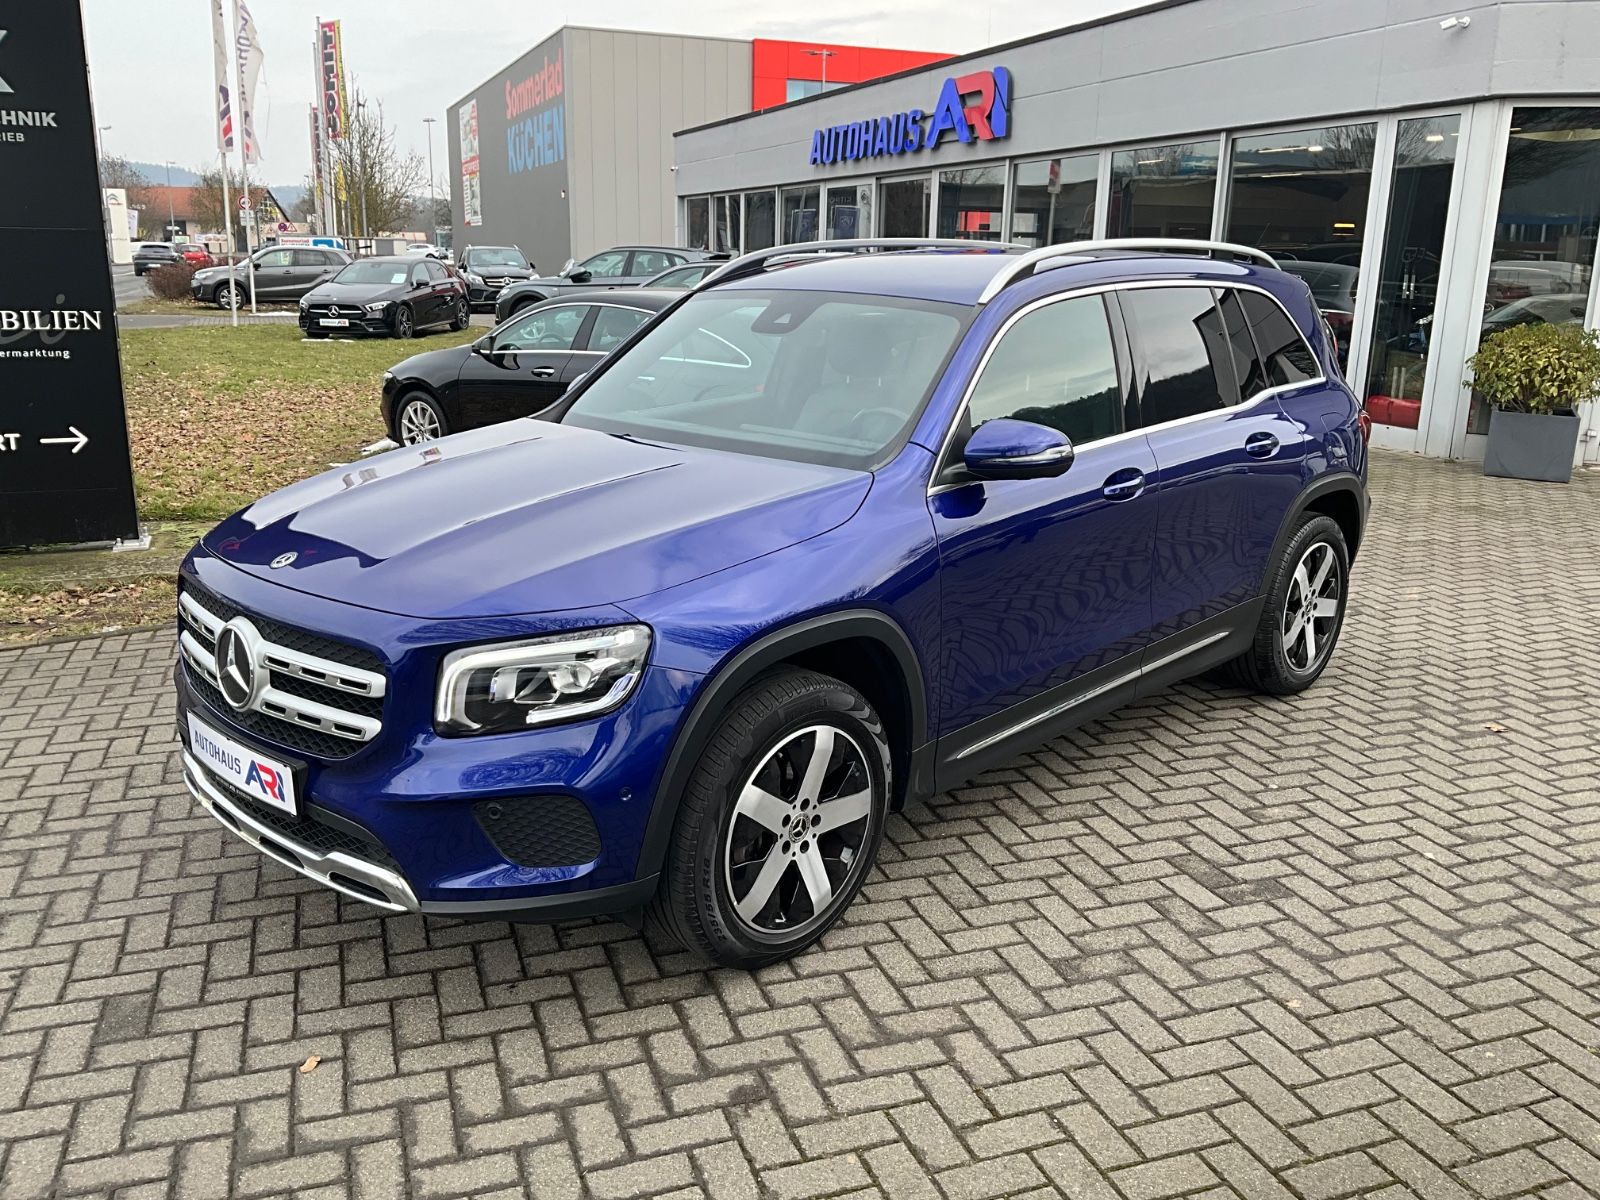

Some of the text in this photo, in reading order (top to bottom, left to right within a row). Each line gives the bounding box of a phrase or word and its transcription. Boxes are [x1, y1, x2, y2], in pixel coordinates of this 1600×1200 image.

[0, 109, 58, 128] HNIK
[505, 48, 564, 120] Sommerlad
[810, 66, 1013, 166] AUTOHAUS ARI
[0, 131, 25, 142] IEB
[507, 104, 566, 175] KÜCHEN
[194, 729, 242, 775] AUTOHAUS
[244, 759, 286, 803] ARI
